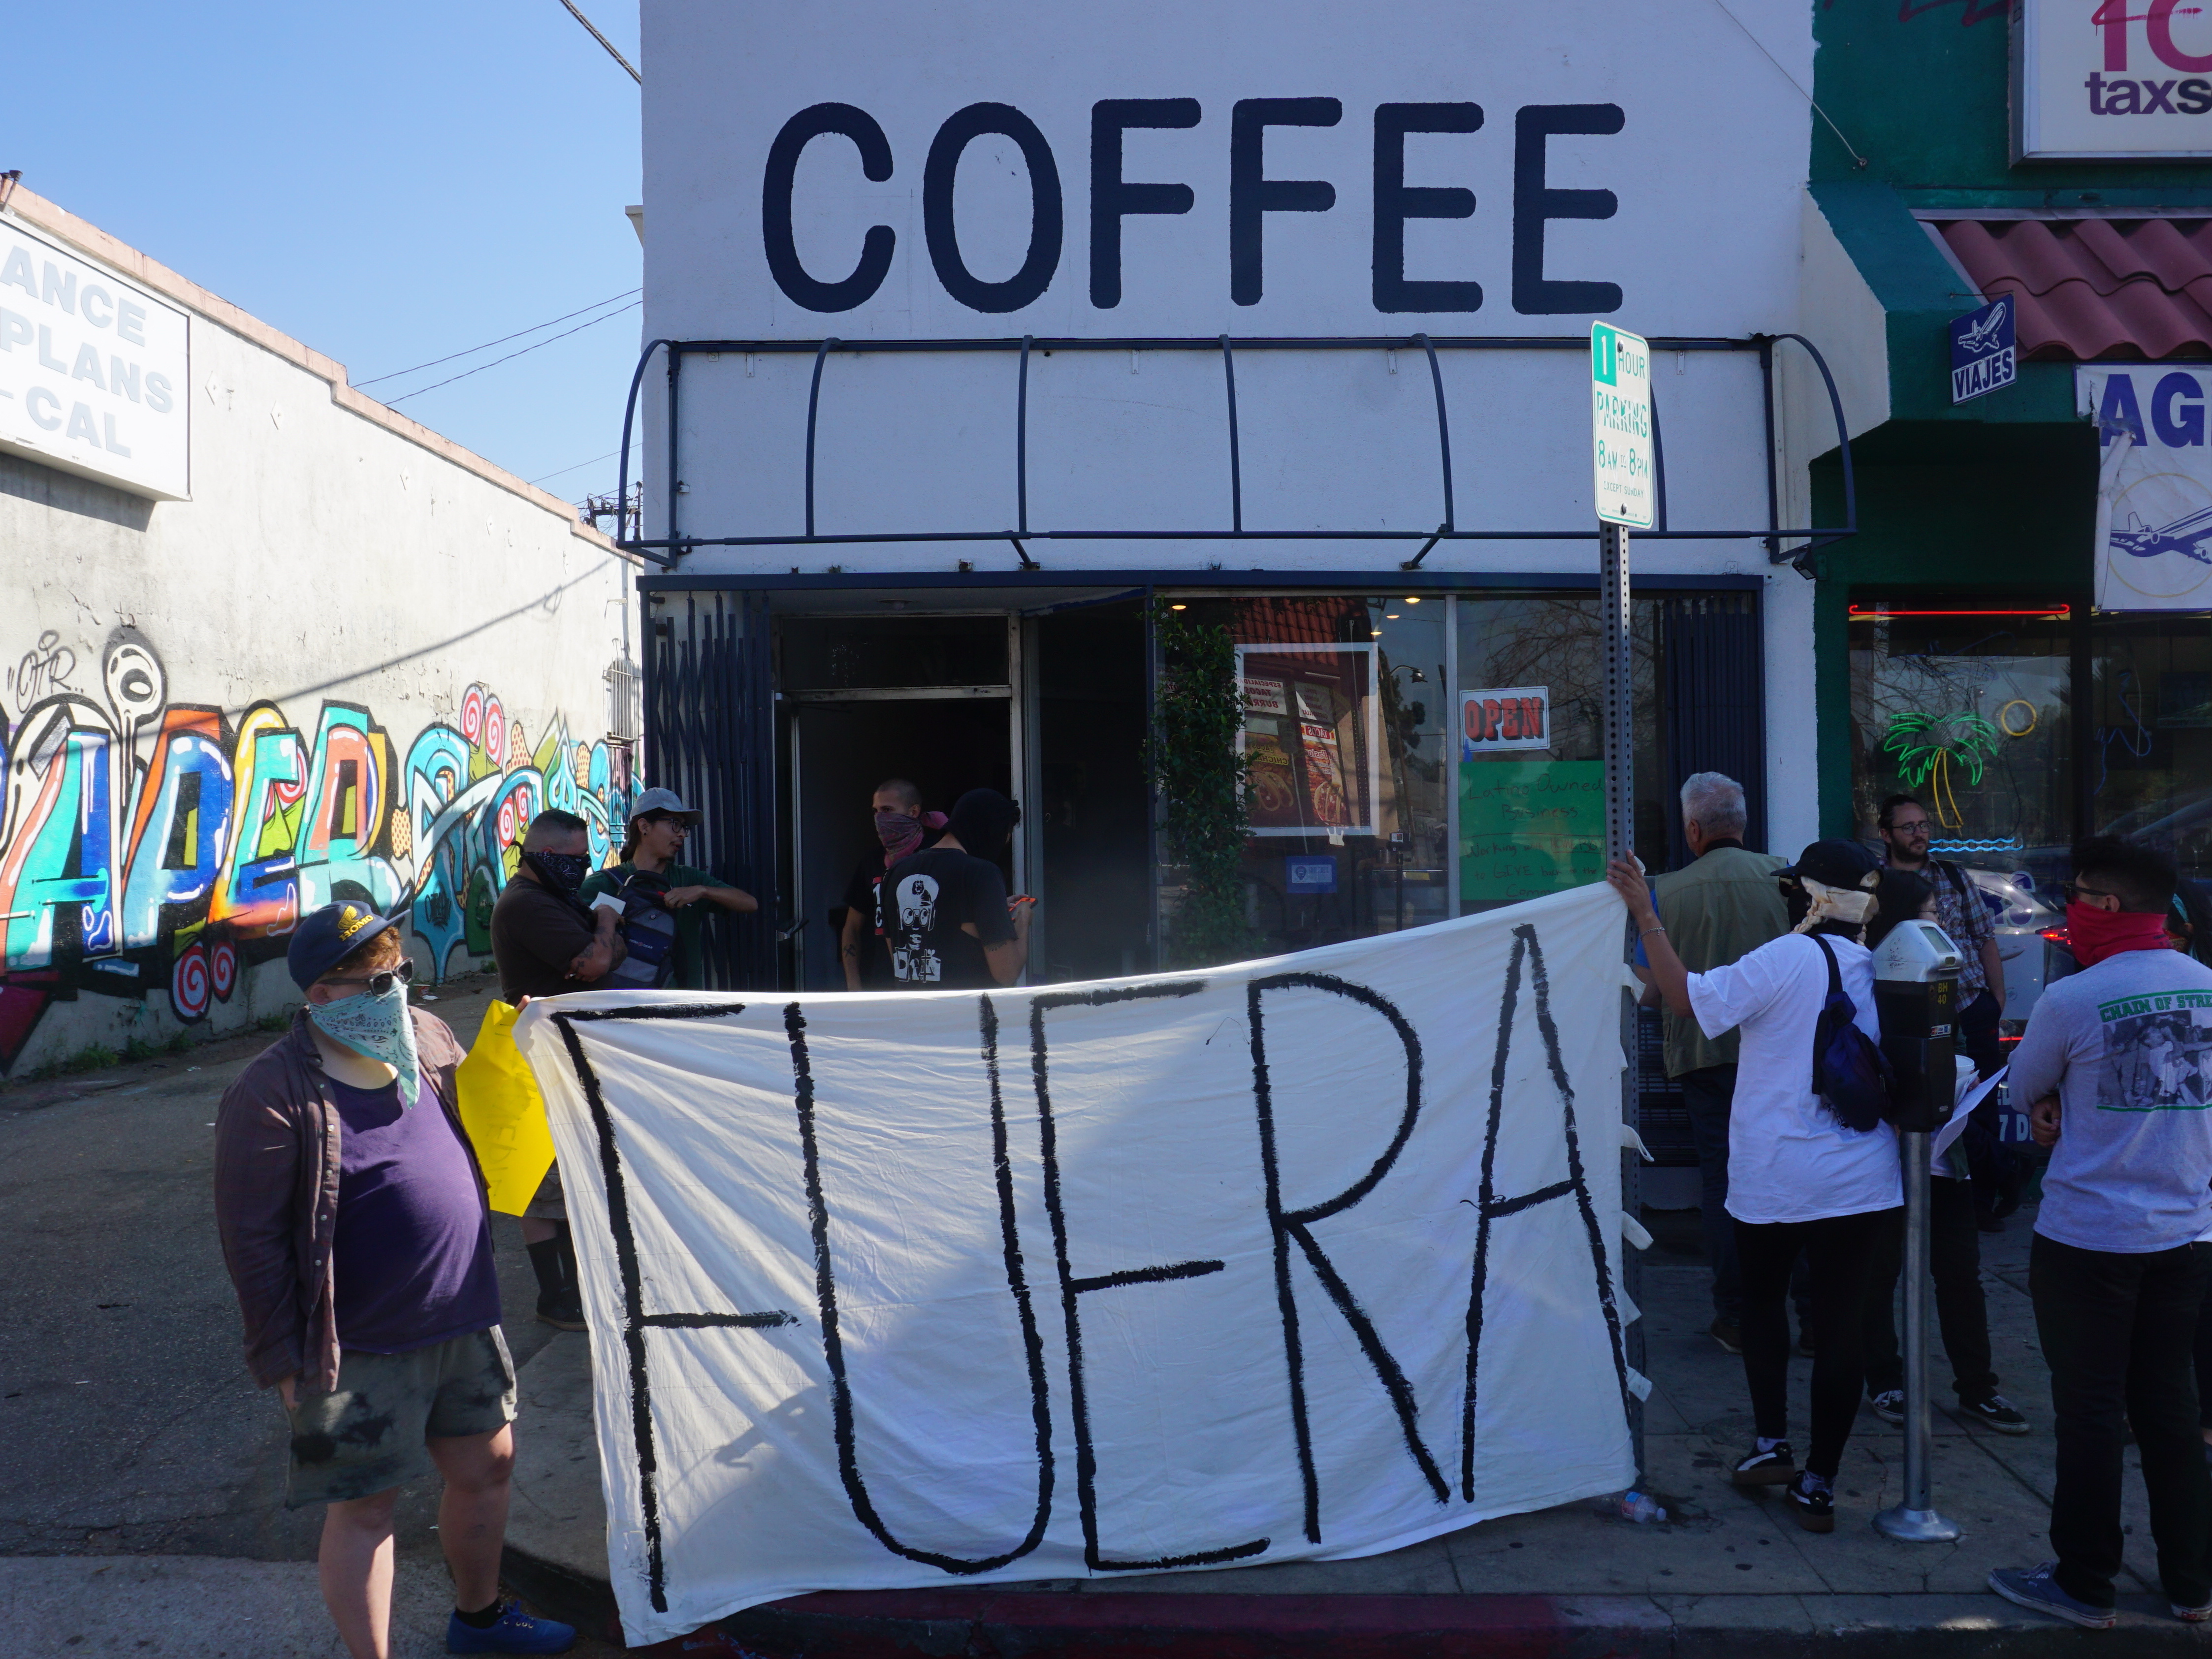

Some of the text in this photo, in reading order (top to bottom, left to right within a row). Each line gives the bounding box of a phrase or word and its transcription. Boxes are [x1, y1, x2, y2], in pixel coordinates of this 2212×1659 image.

[2084, 72, 2212, 115] taxs
[762, 97, 1625, 314] COFFEE
[0, 245, 146, 347] ANCE
[0, 306, 173, 414] PLANS
[1601, 335, 1645, 379] 1 HOUR
[1954, 350, 2013, 398] VIAJES
[1597, 391, 1647, 438] PARKING
[2099, 372, 2212, 448] AG
[1624, 486, 1644, 498] SUNDAY
[1465, 697, 1544, 742] OPEN
[1467, 773, 1605, 800] Latino Owned
[1502, 803, 1579, 821] Business
[1493, 861, 1534, 879] GIVE
[339, 914, 374, 941] HOMO
[1937, 994, 1947, 1005] 40
[1938, 983, 1948, 993] BH
[2100, 998, 2152, 1022] CHAIN
[2154, 996, 2172, 1010] OF
[552, 923, 1631, 1614] FUERA
